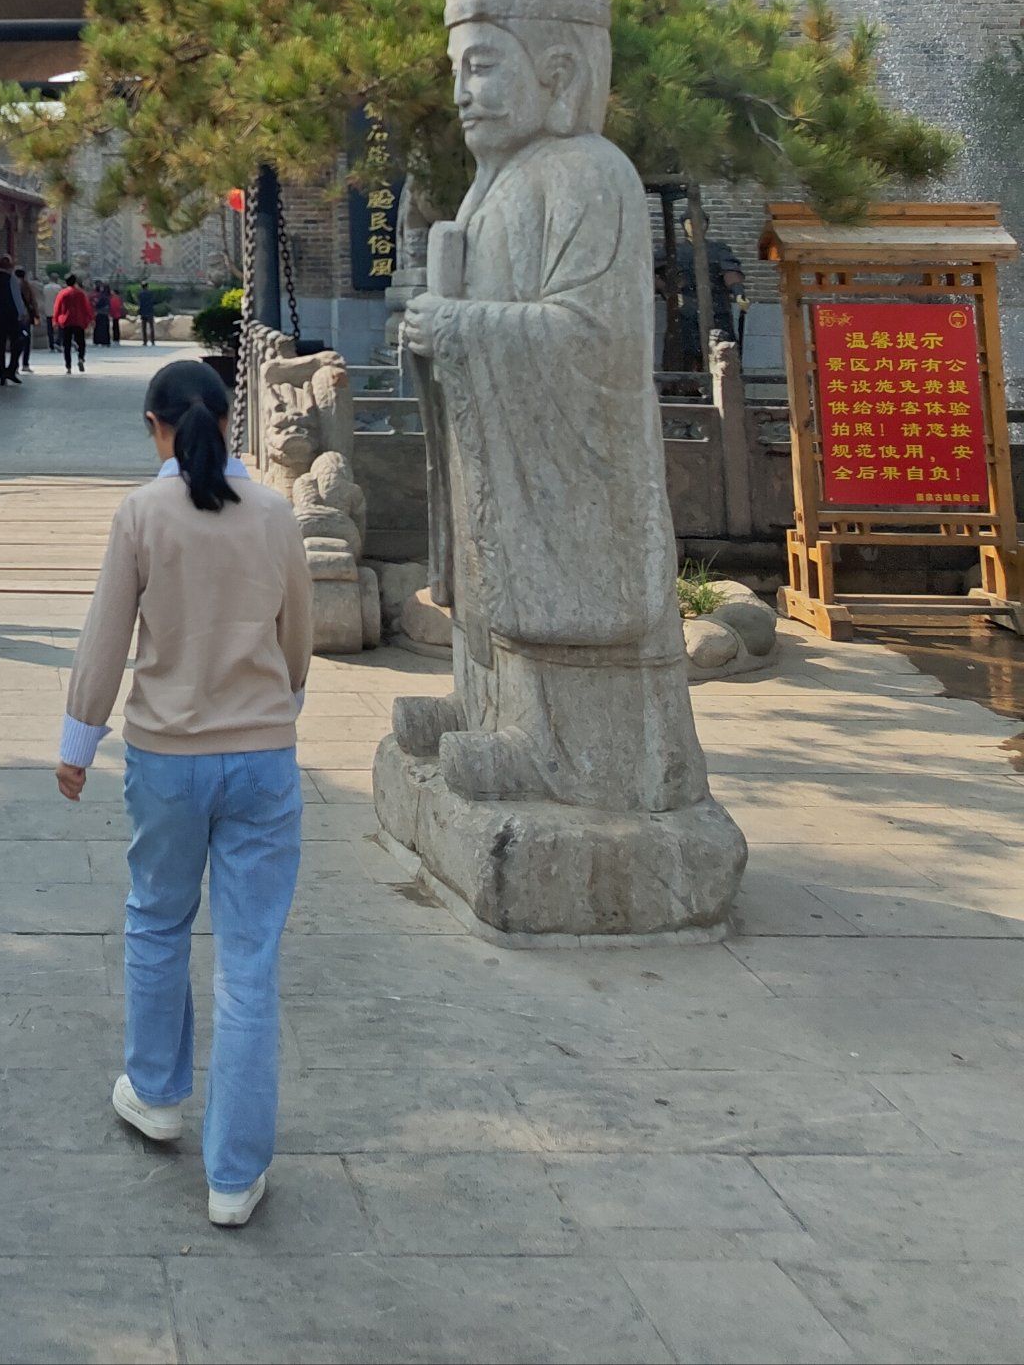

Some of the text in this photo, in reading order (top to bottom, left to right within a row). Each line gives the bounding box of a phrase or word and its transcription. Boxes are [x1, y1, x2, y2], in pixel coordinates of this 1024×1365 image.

[844, 331, 944, 350] 温馨提示
[825, 357, 967, 372] 景区内所有公
[827, 379, 970, 394] 共设施免费提
[828, 401, 971, 416] 供给游客体验
[832, 466, 961, 481] 全后果自负！
